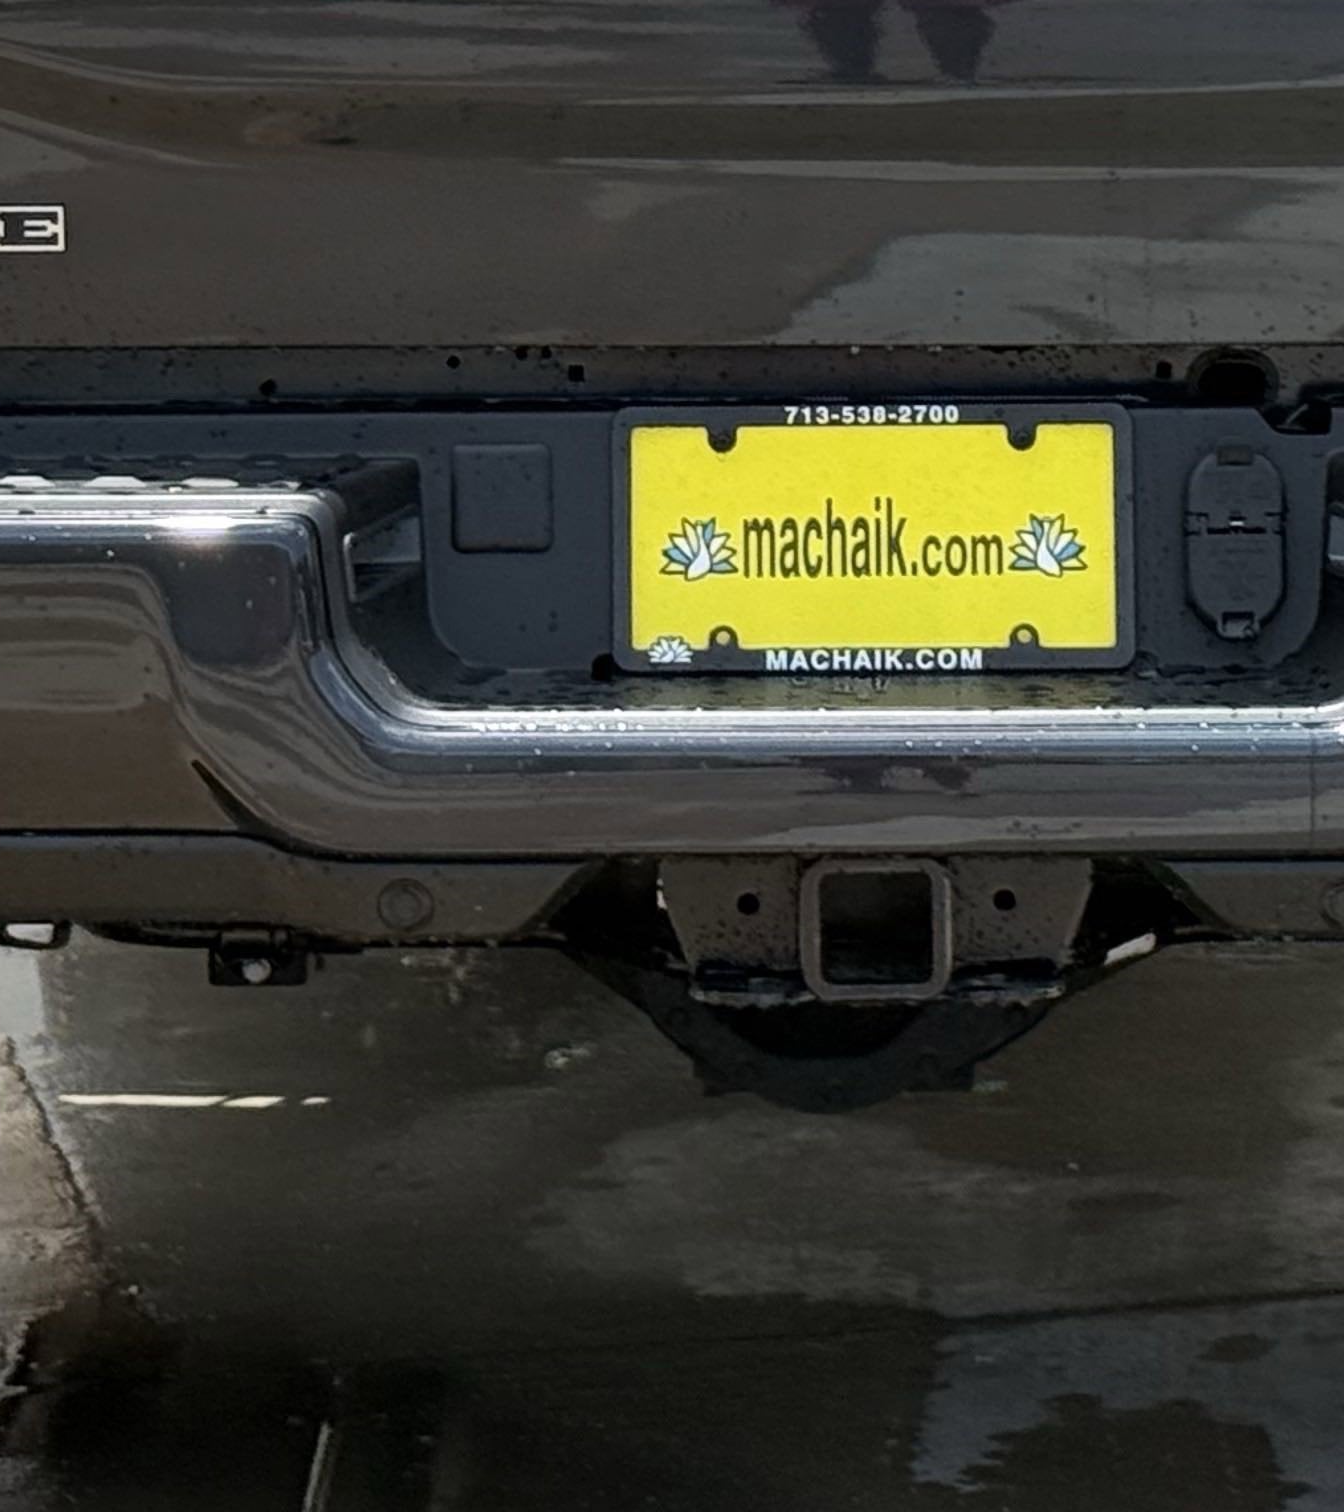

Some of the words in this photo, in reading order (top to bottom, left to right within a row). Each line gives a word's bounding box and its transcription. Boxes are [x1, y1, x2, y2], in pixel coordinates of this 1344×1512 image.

[783, 405, 960, 425] 713-538-2700
[742, 496, 1004, 579] machaik.com
[764, 648, 984, 671] MACHAIK.COM
